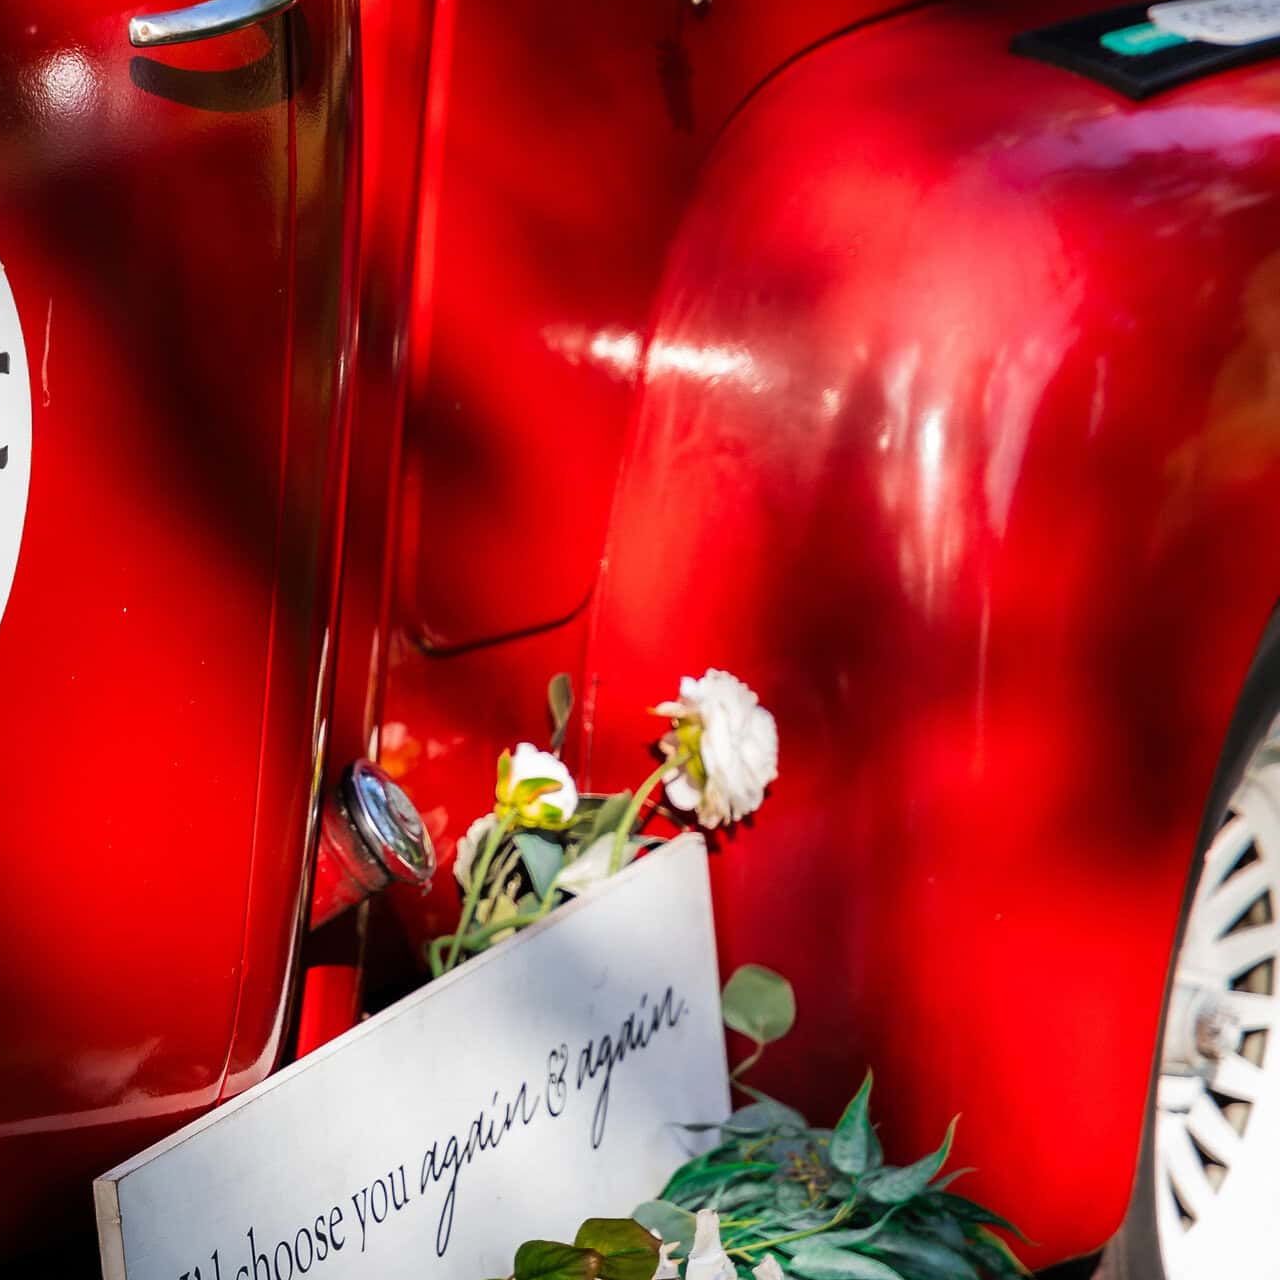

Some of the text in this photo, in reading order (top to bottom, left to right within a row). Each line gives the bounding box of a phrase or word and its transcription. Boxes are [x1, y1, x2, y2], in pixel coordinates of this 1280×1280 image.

[351, 1165, 410, 1252] you
[420, 1081, 540, 1257] again
[546, 1043, 568, 1117] &
